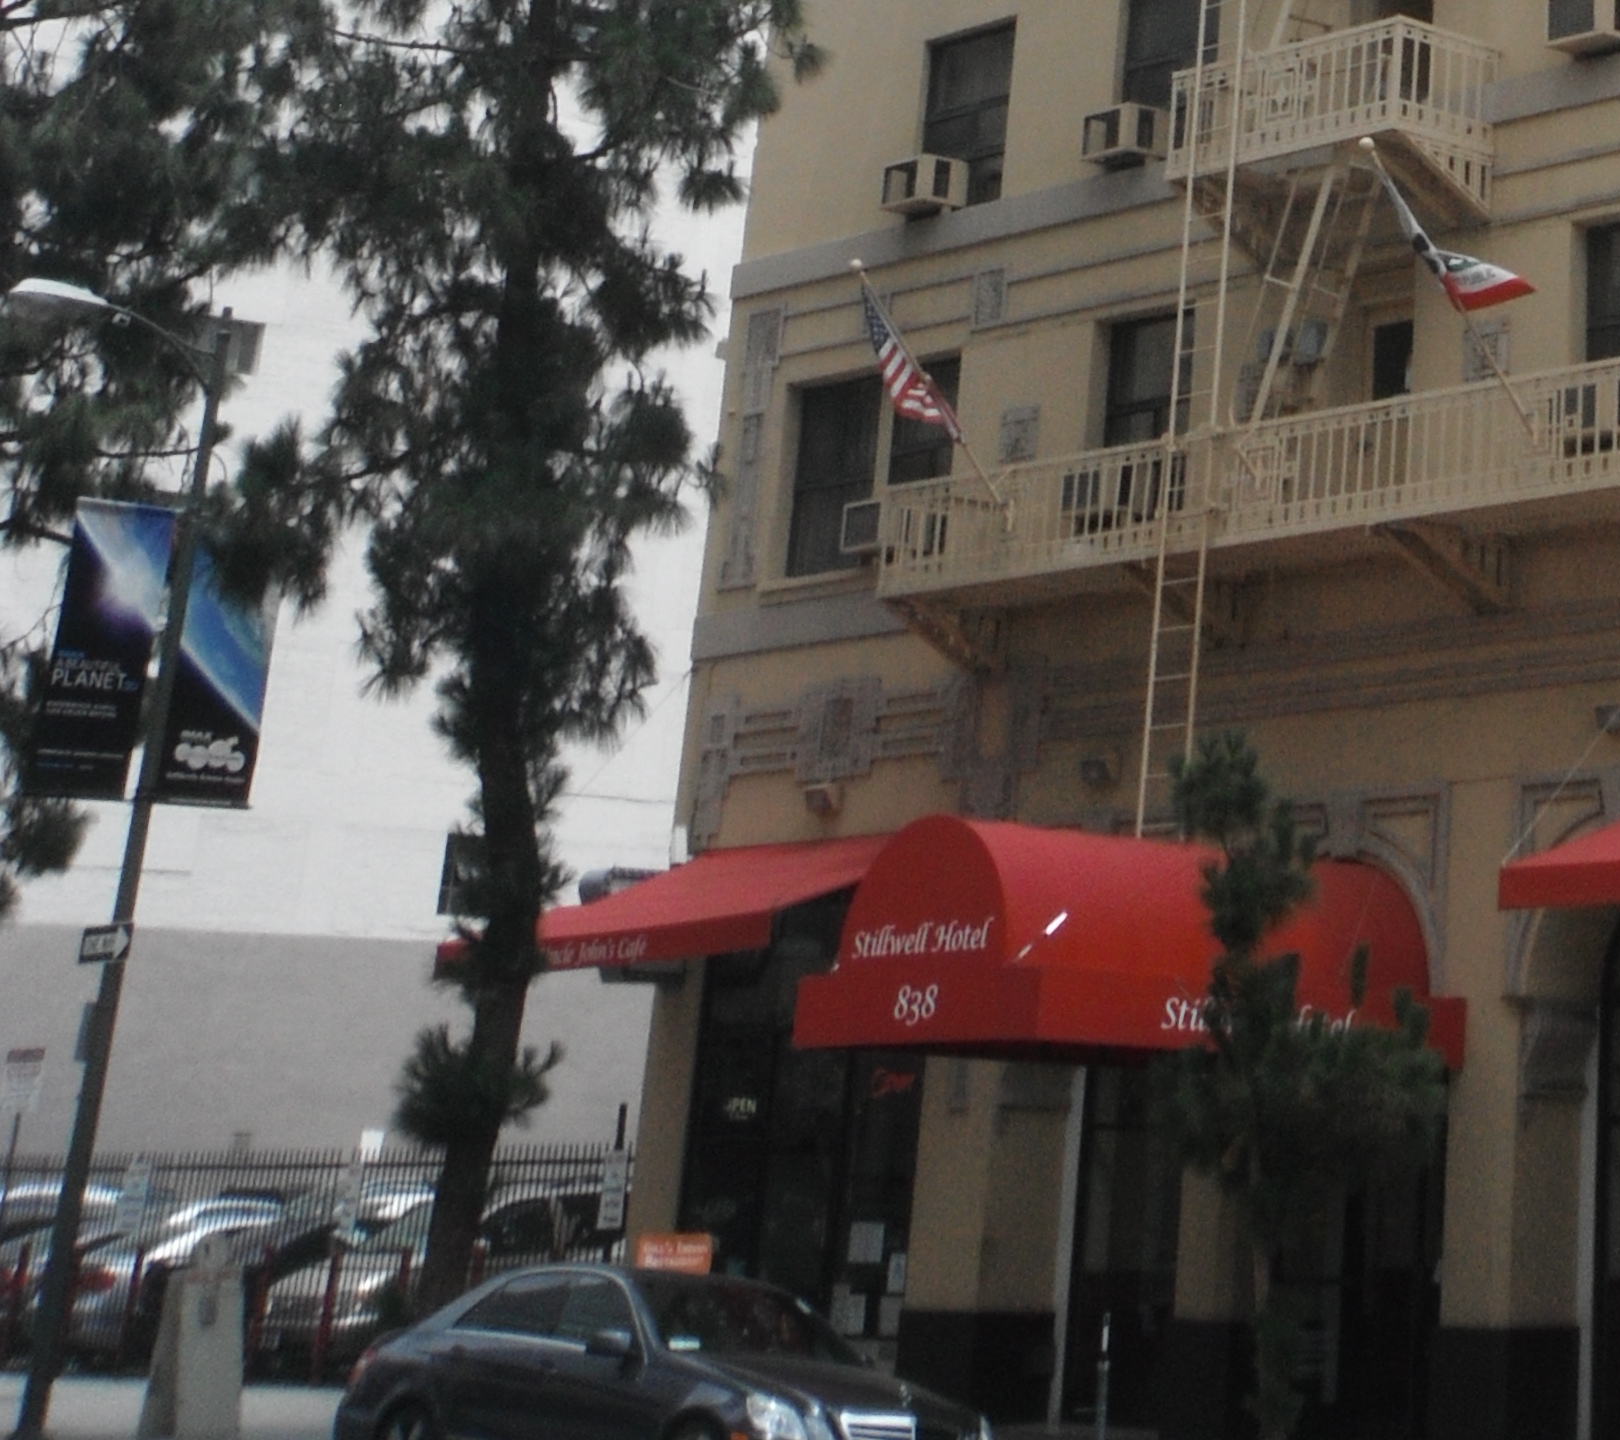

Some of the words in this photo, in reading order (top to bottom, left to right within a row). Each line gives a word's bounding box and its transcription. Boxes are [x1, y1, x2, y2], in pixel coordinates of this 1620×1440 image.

[51, 668, 128, 690] PLANET
[852, 924, 935, 960] Stillwell
[931, 916, 995, 953] Hotel
[893, 983, 940, 1027] 838
